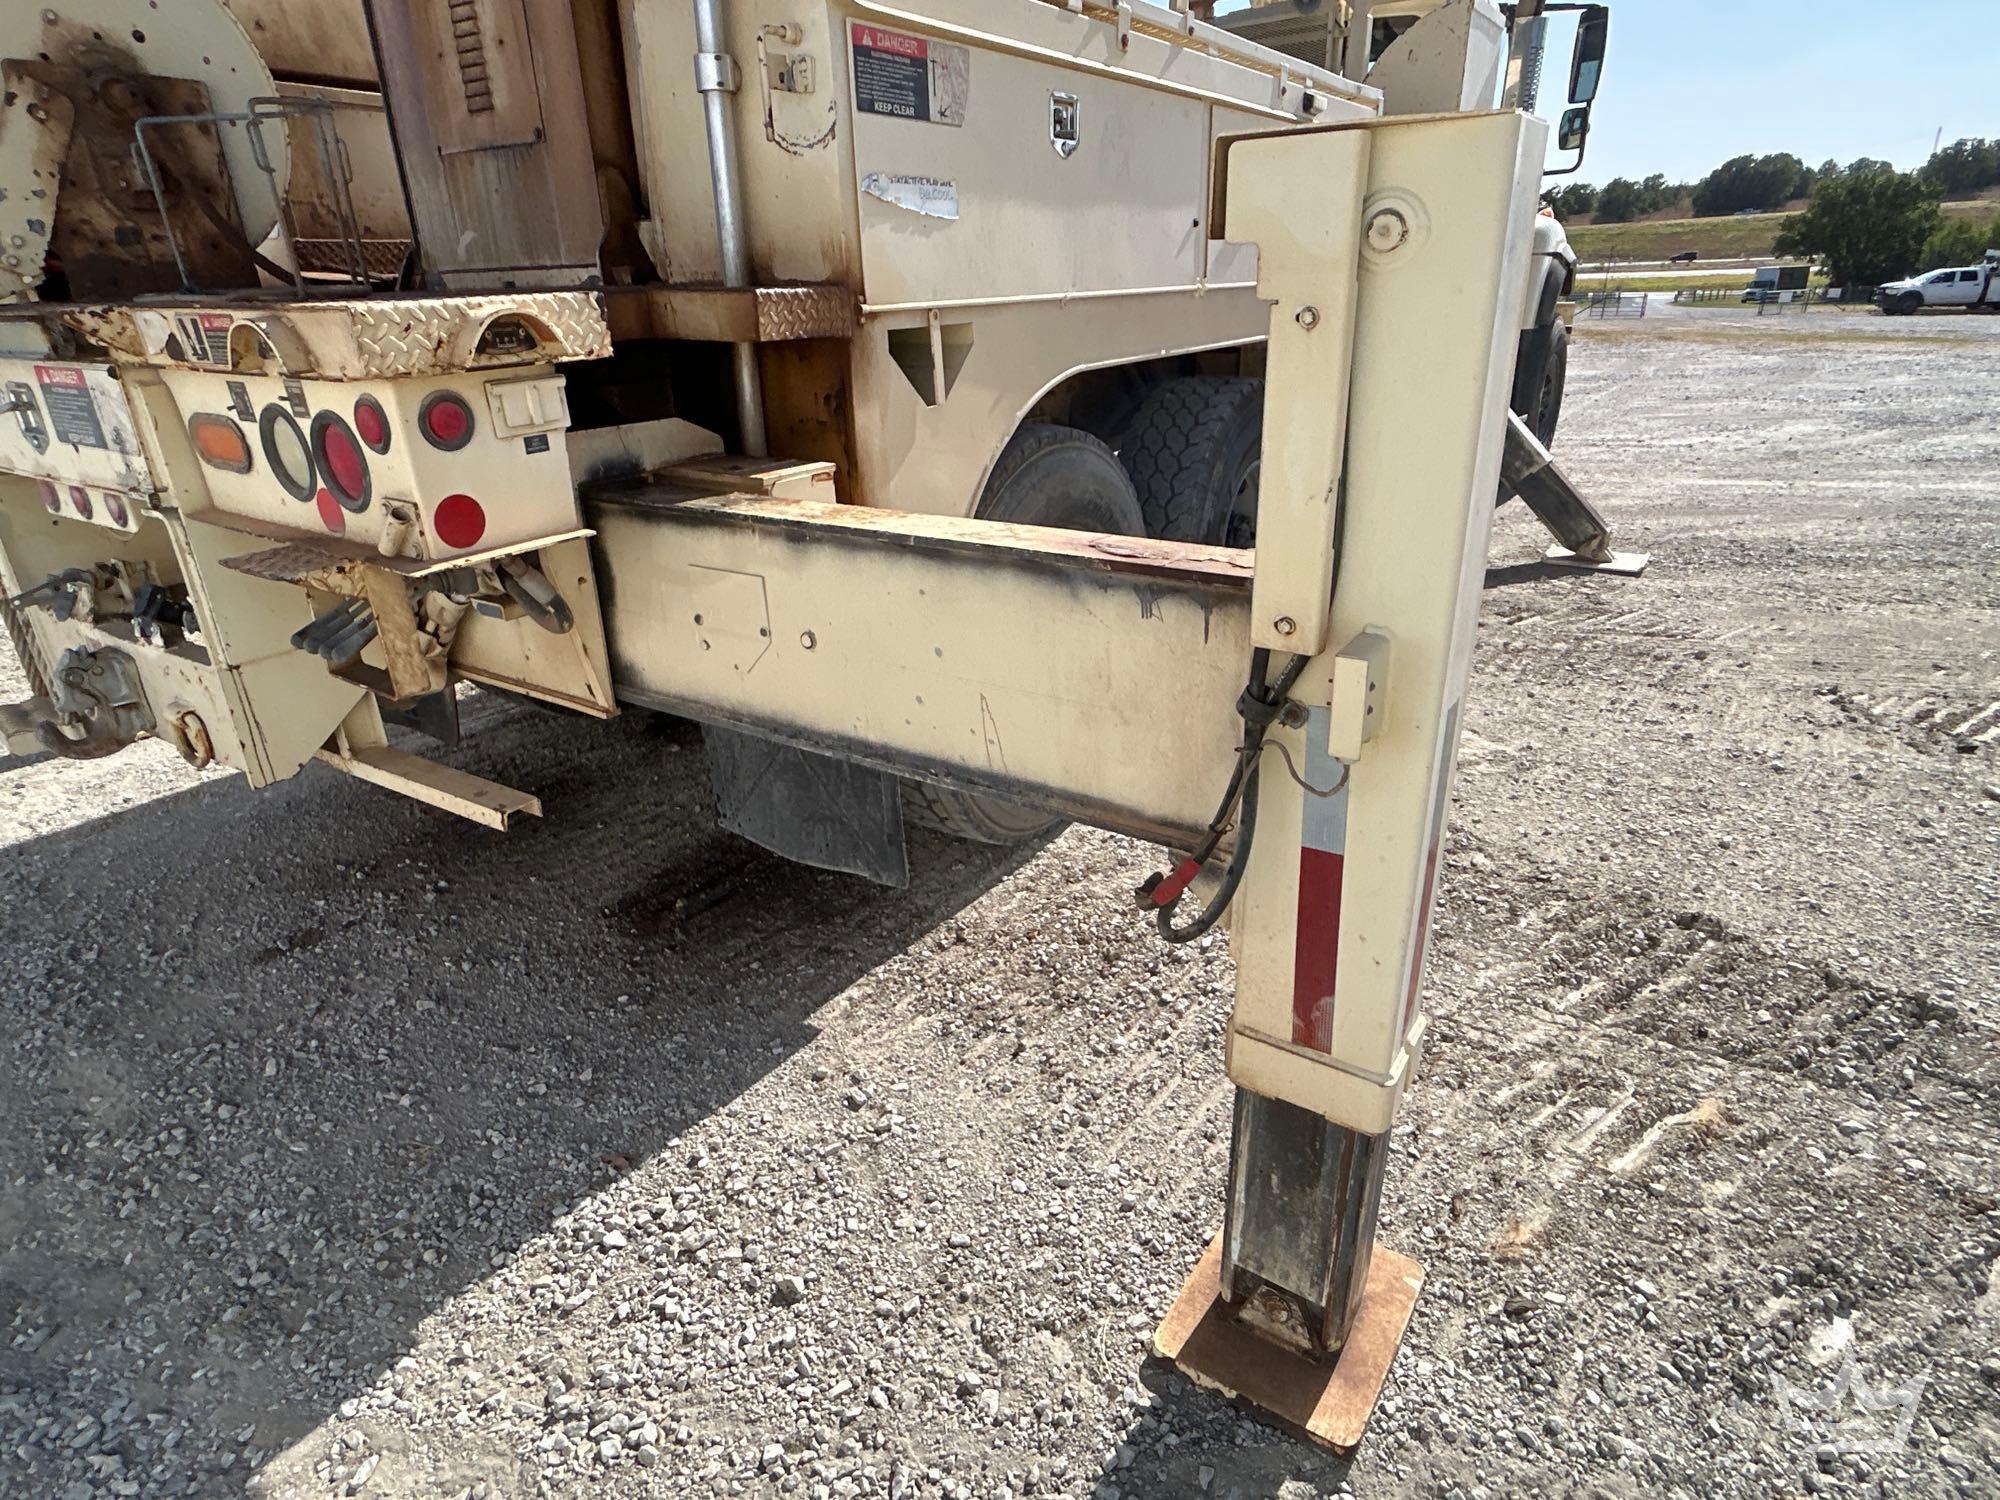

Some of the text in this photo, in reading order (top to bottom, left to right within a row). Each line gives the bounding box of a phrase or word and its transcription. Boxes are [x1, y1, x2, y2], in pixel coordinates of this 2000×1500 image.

[876, 32, 918, 52] DANGER
[874, 101, 915, 116] KEEP CLEAR
[48, 369, 78, 384] DANGER
